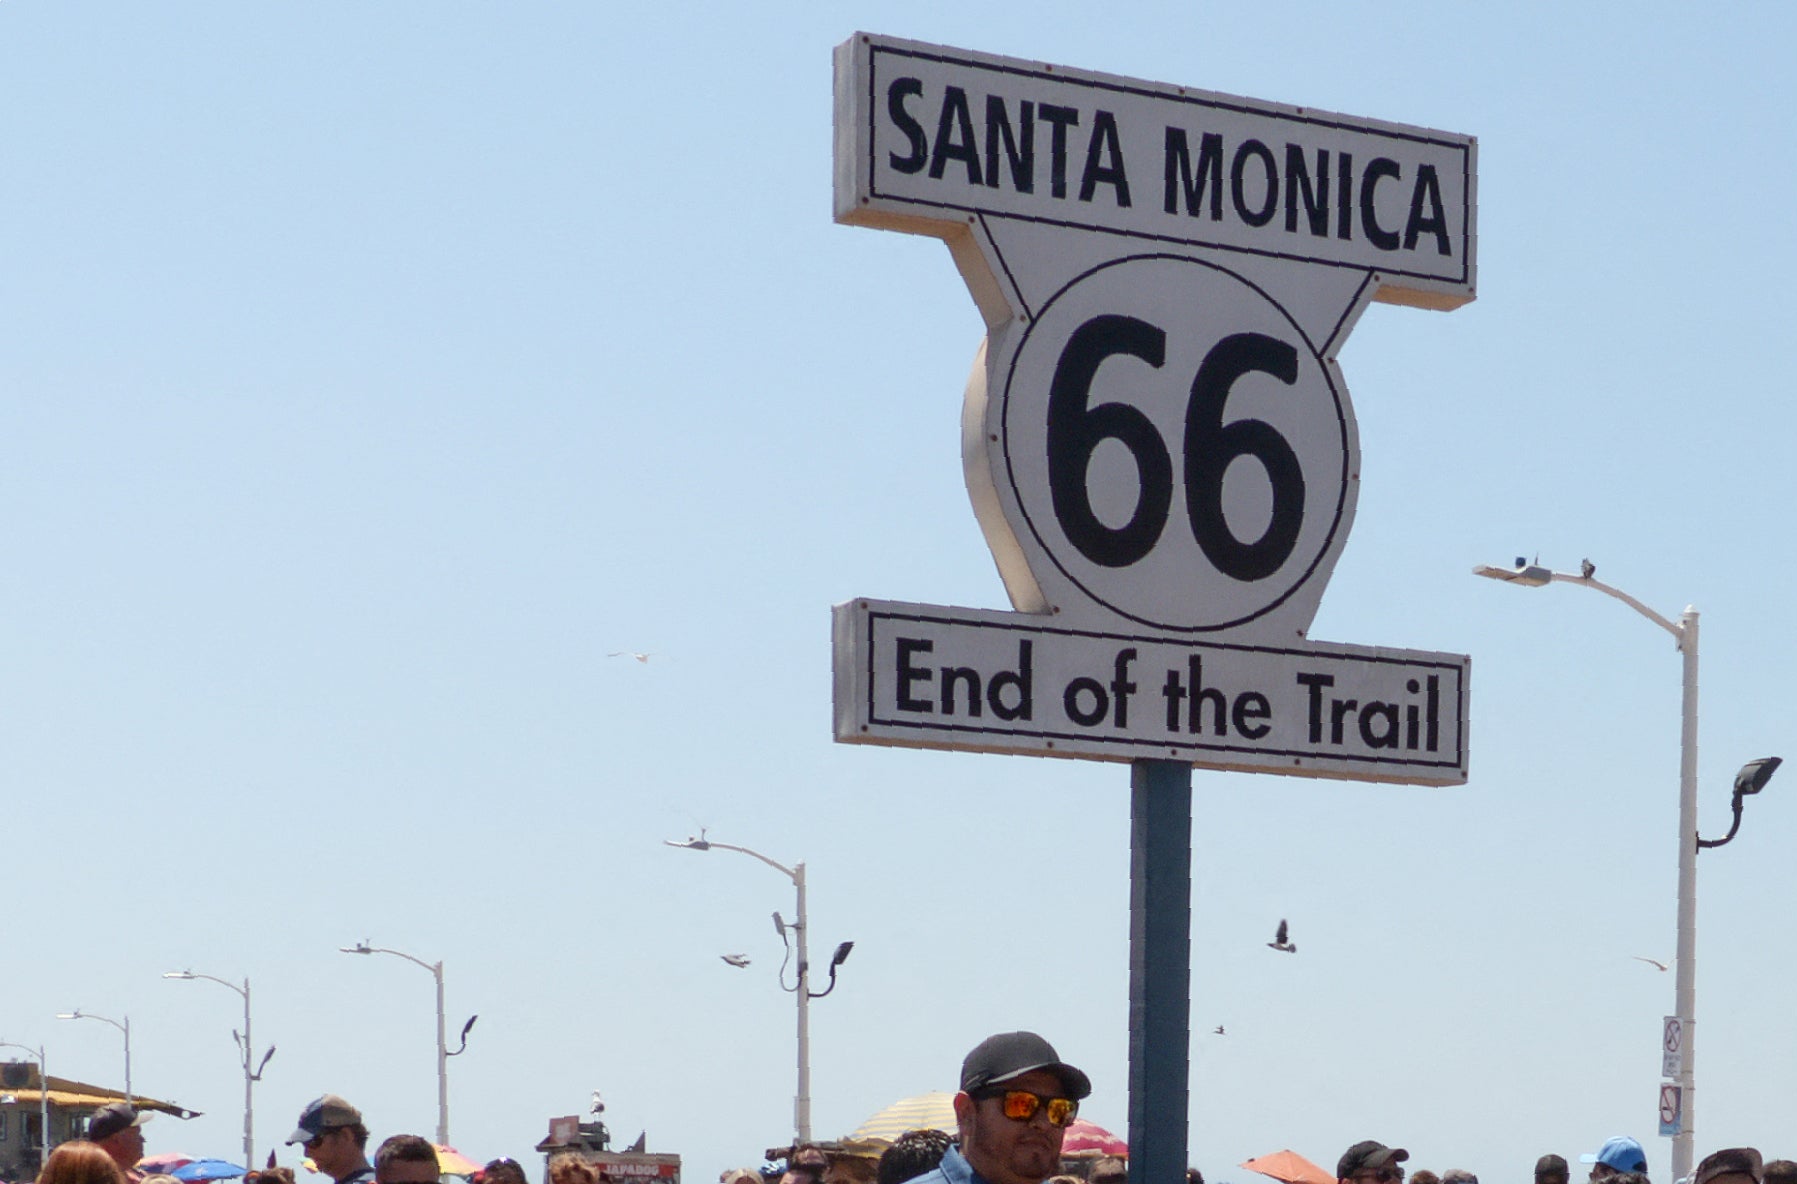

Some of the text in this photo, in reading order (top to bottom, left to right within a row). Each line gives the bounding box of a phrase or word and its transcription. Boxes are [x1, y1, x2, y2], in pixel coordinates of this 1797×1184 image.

[888, 77, 1452, 257] SANTA MONICA
[1047, 313, 1306, 583] 66
[896, 637, 1439, 753] End of the Trail
